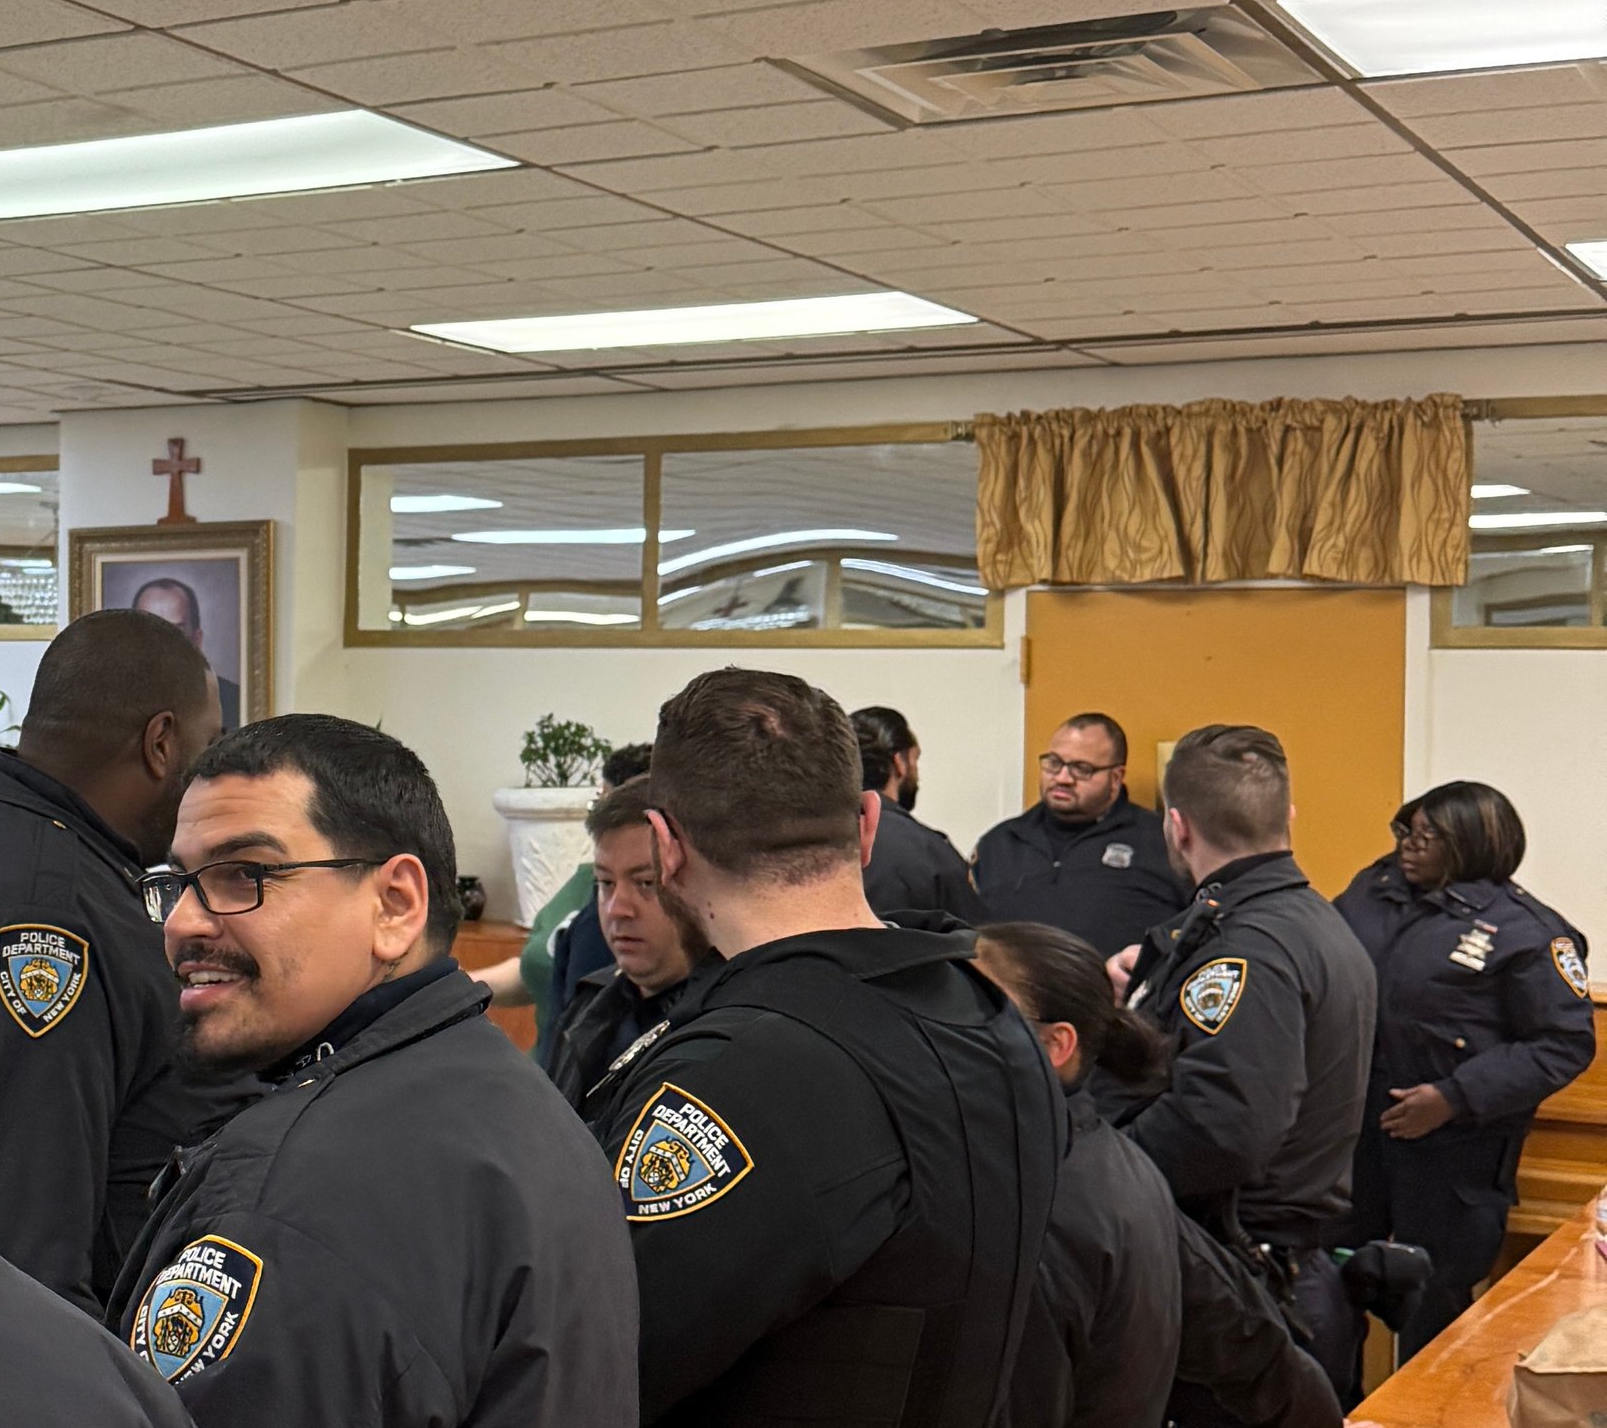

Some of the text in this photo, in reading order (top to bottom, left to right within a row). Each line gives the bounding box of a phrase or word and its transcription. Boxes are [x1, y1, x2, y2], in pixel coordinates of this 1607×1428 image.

[2, 943, 81, 965] DEPARTMENT
[20, 932, 66, 948] POLICE
[0, 971, 28, 1015] CITY OF
[43, 972, 82, 1023] NEW YORK
[652, 1104, 732, 1178] DEPARTMENT
[679, 1103, 729, 1150] POLICE
[625, 1129, 644, 1164] CITY
[638, 1182, 718, 1215] NEW YORK
[178, 1246, 227, 1269] POLICE
[156, 1262, 242, 1300] DEPARTMENT
[203, 1311, 239, 1358] YORK
